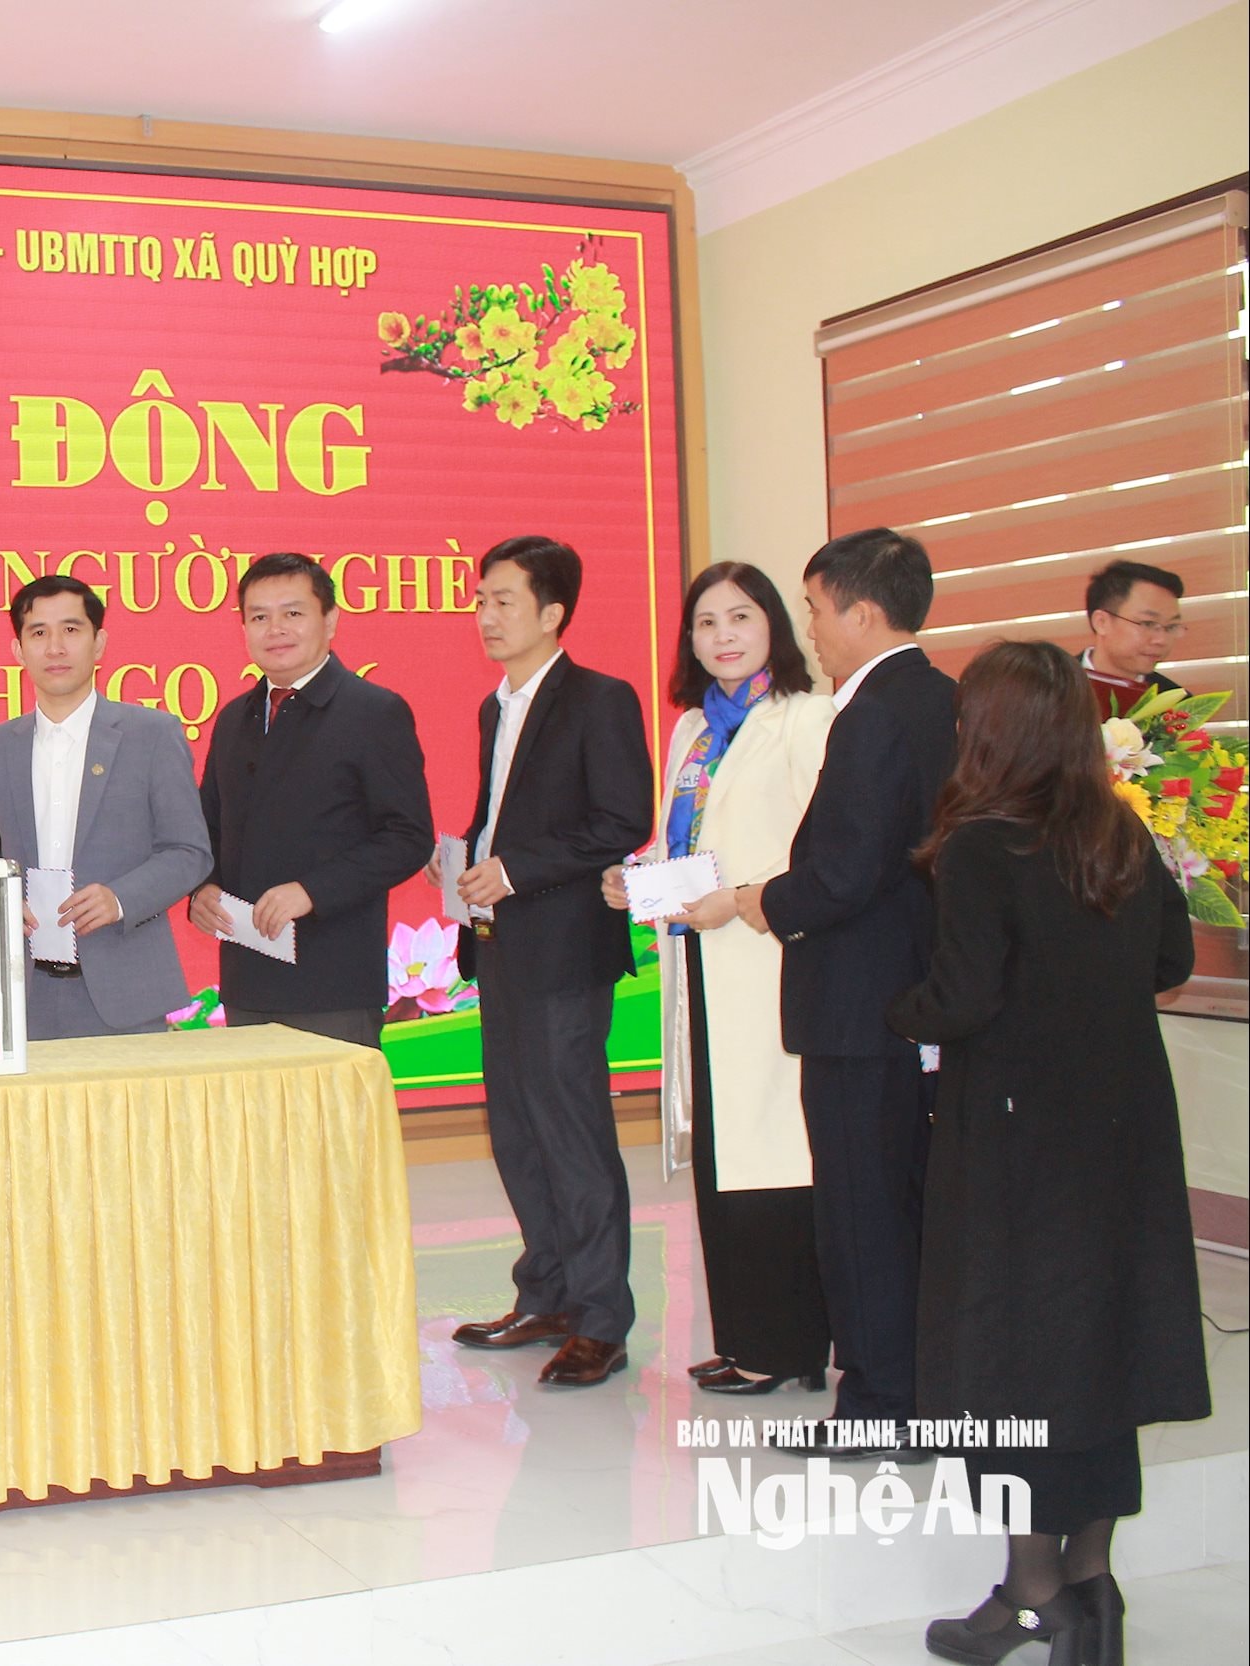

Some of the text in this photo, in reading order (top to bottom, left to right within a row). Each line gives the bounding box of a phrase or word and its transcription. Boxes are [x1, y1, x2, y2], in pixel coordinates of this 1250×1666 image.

[15, 228, 163, 283] UBMTTQ
[173, 232, 222, 281] XÃ
[232, 236, 300, 288] QUỲ
[310, 245, 378, 297] HỢP
[9, 369, 372, 526] ĐỘNG
[91, 663, 219, 741] GỌ
